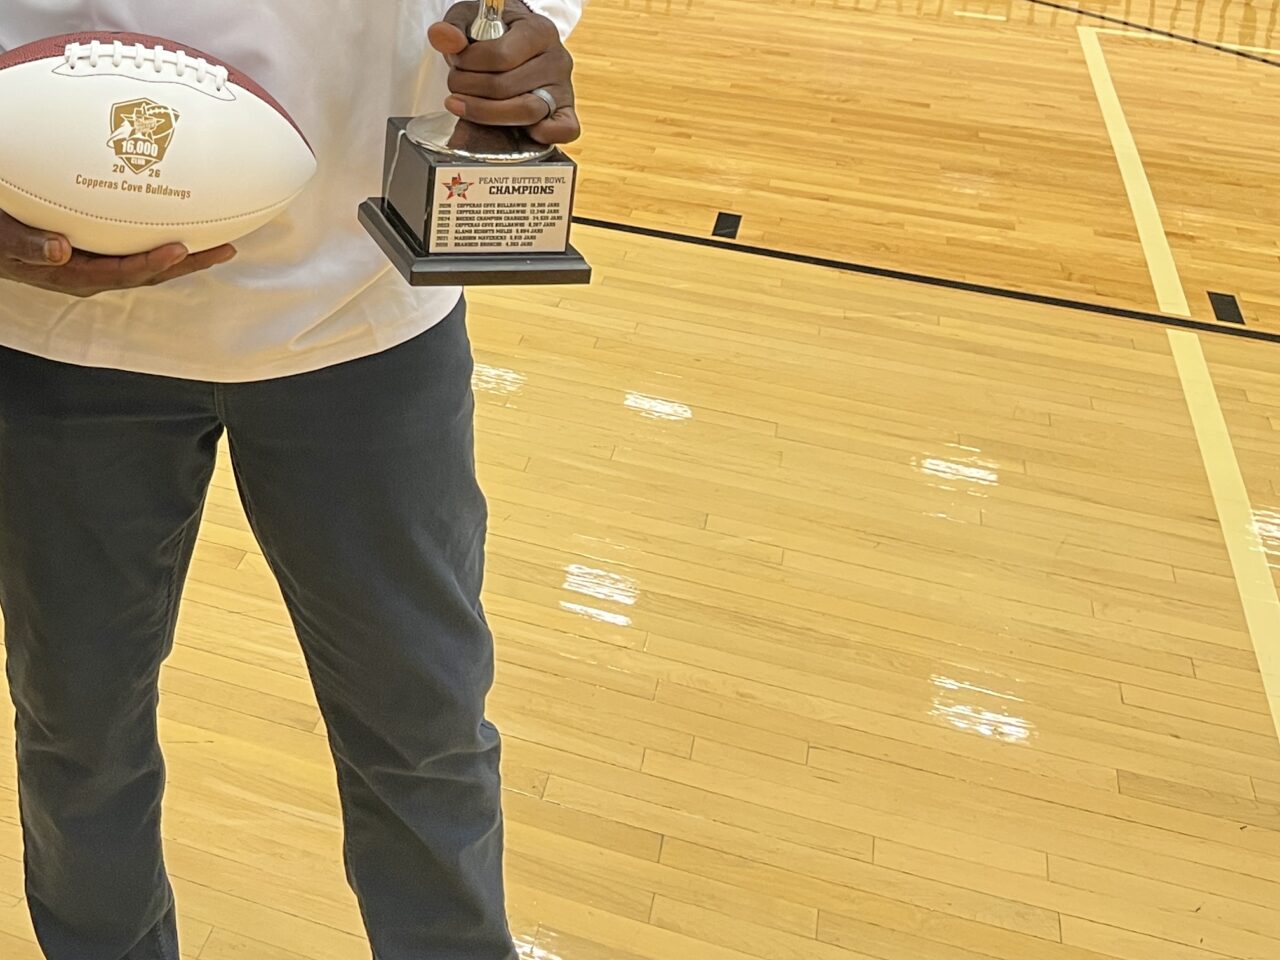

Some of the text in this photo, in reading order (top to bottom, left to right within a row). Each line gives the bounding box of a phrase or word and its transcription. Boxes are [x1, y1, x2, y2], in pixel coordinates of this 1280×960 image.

[121, 140, 158, 157] 16,000
[112, 164, 160, 178] 20 26
[76, 174, 191, 200] Copperas Cove Bulldawgs
[478, 176, 566, 184] PEANUT BUTTER BOWL
[488, 185, 555, 195] CHAMPIONS
